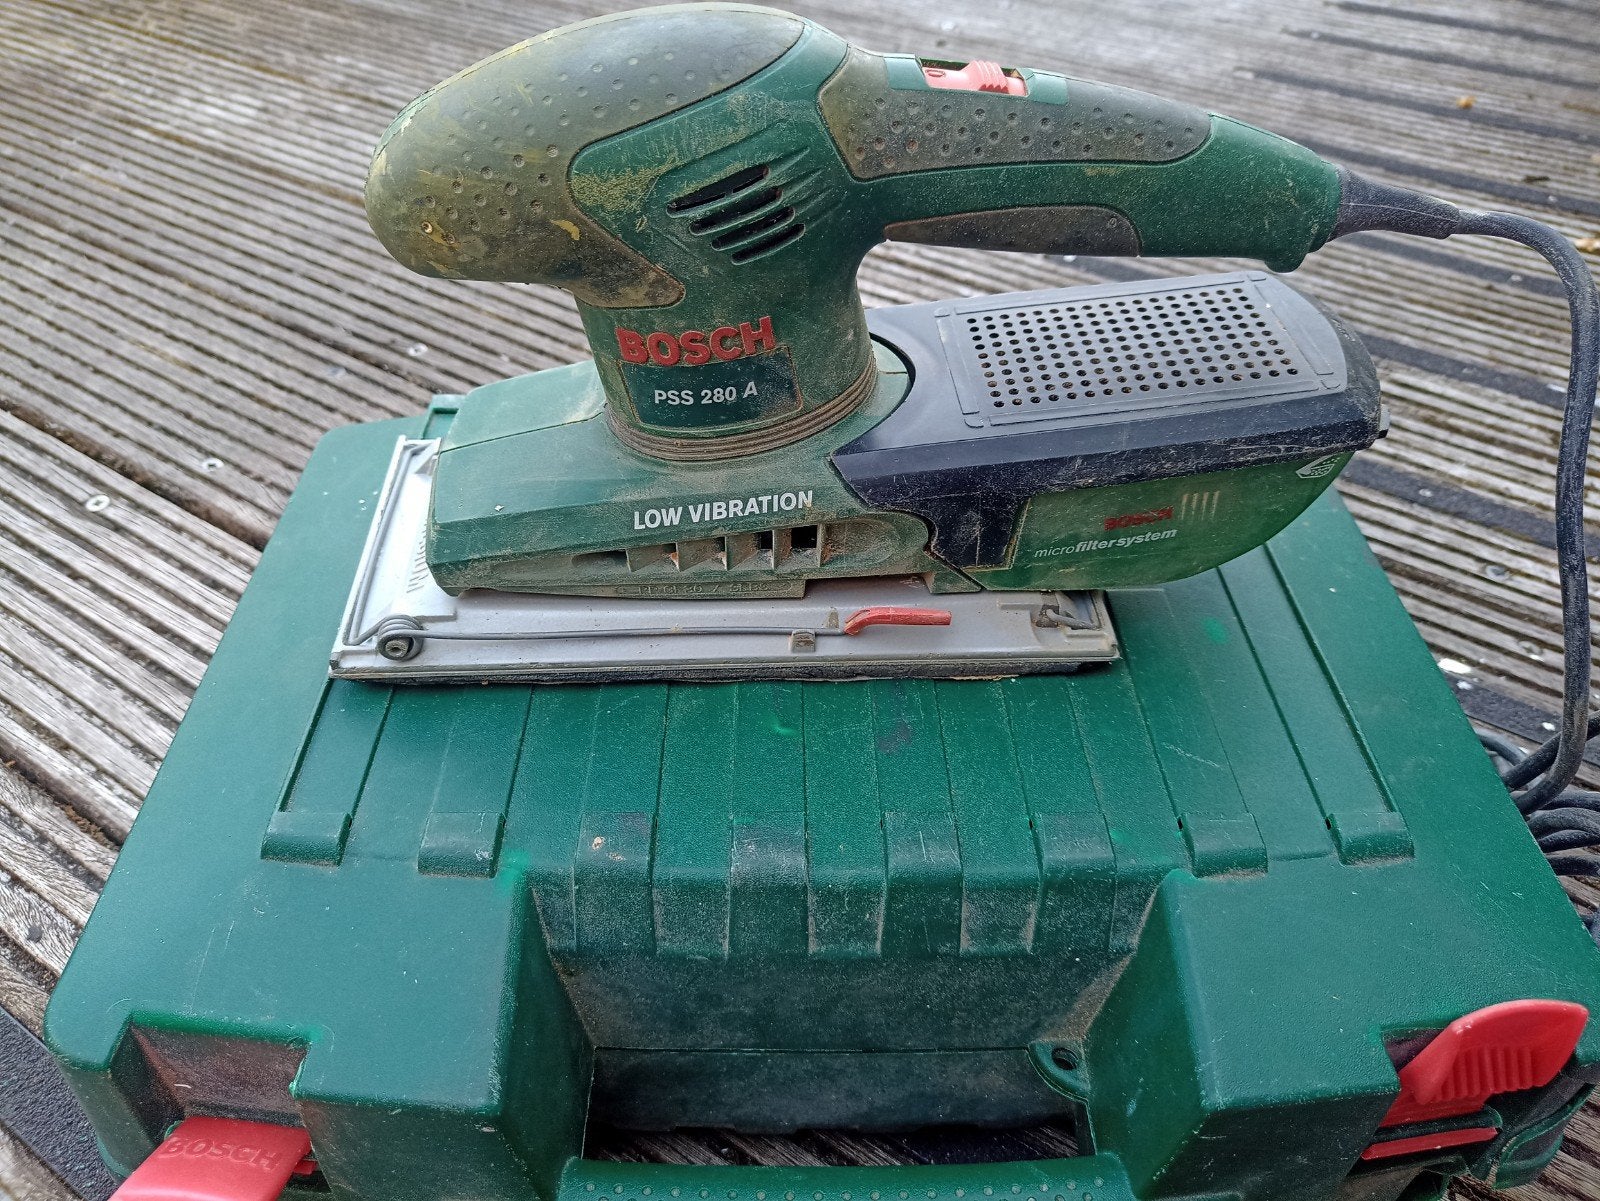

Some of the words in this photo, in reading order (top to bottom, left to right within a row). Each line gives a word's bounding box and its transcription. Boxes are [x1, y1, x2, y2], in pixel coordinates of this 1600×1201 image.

[615, 315, 776, 367] BOSCH
[654, 389, 694, 406] PSS
[701, 386, 737, 405] 280
[742, 381, 758, 399] A
[633, 506, 683, 530] LOW
[688, 490, 813, 523] VIBRATION
[1104, 505, 1174, 531] BOSCH
[1034, 528, 1178, 559] microfiltersystem
[157, 1136, 280, 1172] BOSCH
